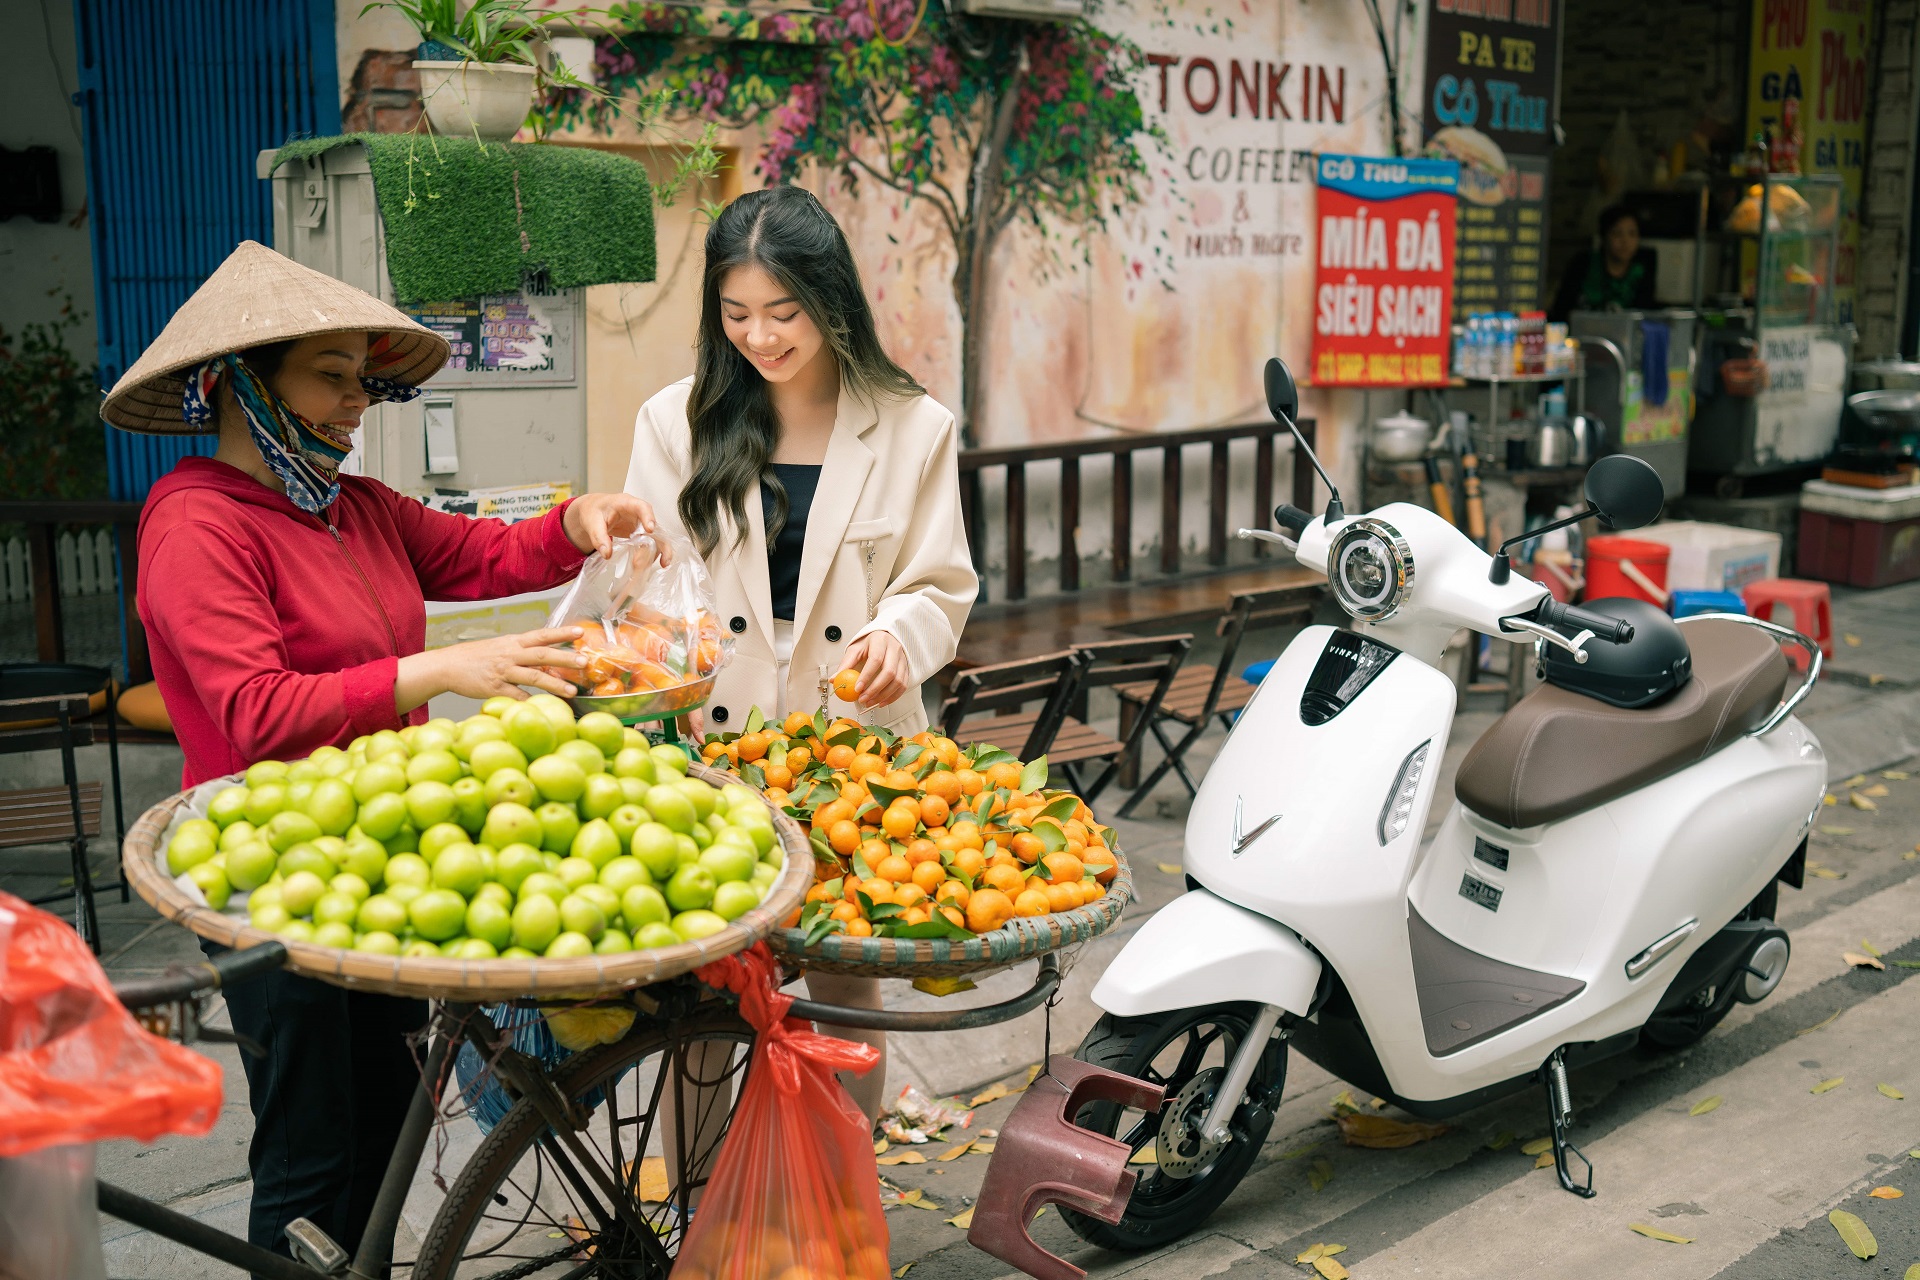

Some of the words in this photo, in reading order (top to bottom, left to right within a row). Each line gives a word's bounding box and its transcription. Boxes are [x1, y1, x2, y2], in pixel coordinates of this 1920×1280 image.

[1457, 30, 1496, 68] PA
[1500, 36, 1536, 73] TE
[1147, 53, 1345, 125] TONKIN
[1761, 64, 1803, 101] GÀ
[1433, 73, 1479, 125] Cô
[1484, 79, 1548, 134] Thu
[1186, 147, 1305, 183] COFFEE
[1321, 157, 1356, 181] CÔ
[1362, 162, 1408, 184] THU
[1232, 190, 1249, 222] &
[1320, 206, 1389, 270] MÍA
[1395, 209, 1443, 272] ĐÁ
[1317, 273, 1375, 337] SIÊU
[1376, 284, 1443, 349] SẠCH
[1329, 645, 1374, 667] VINFAST
